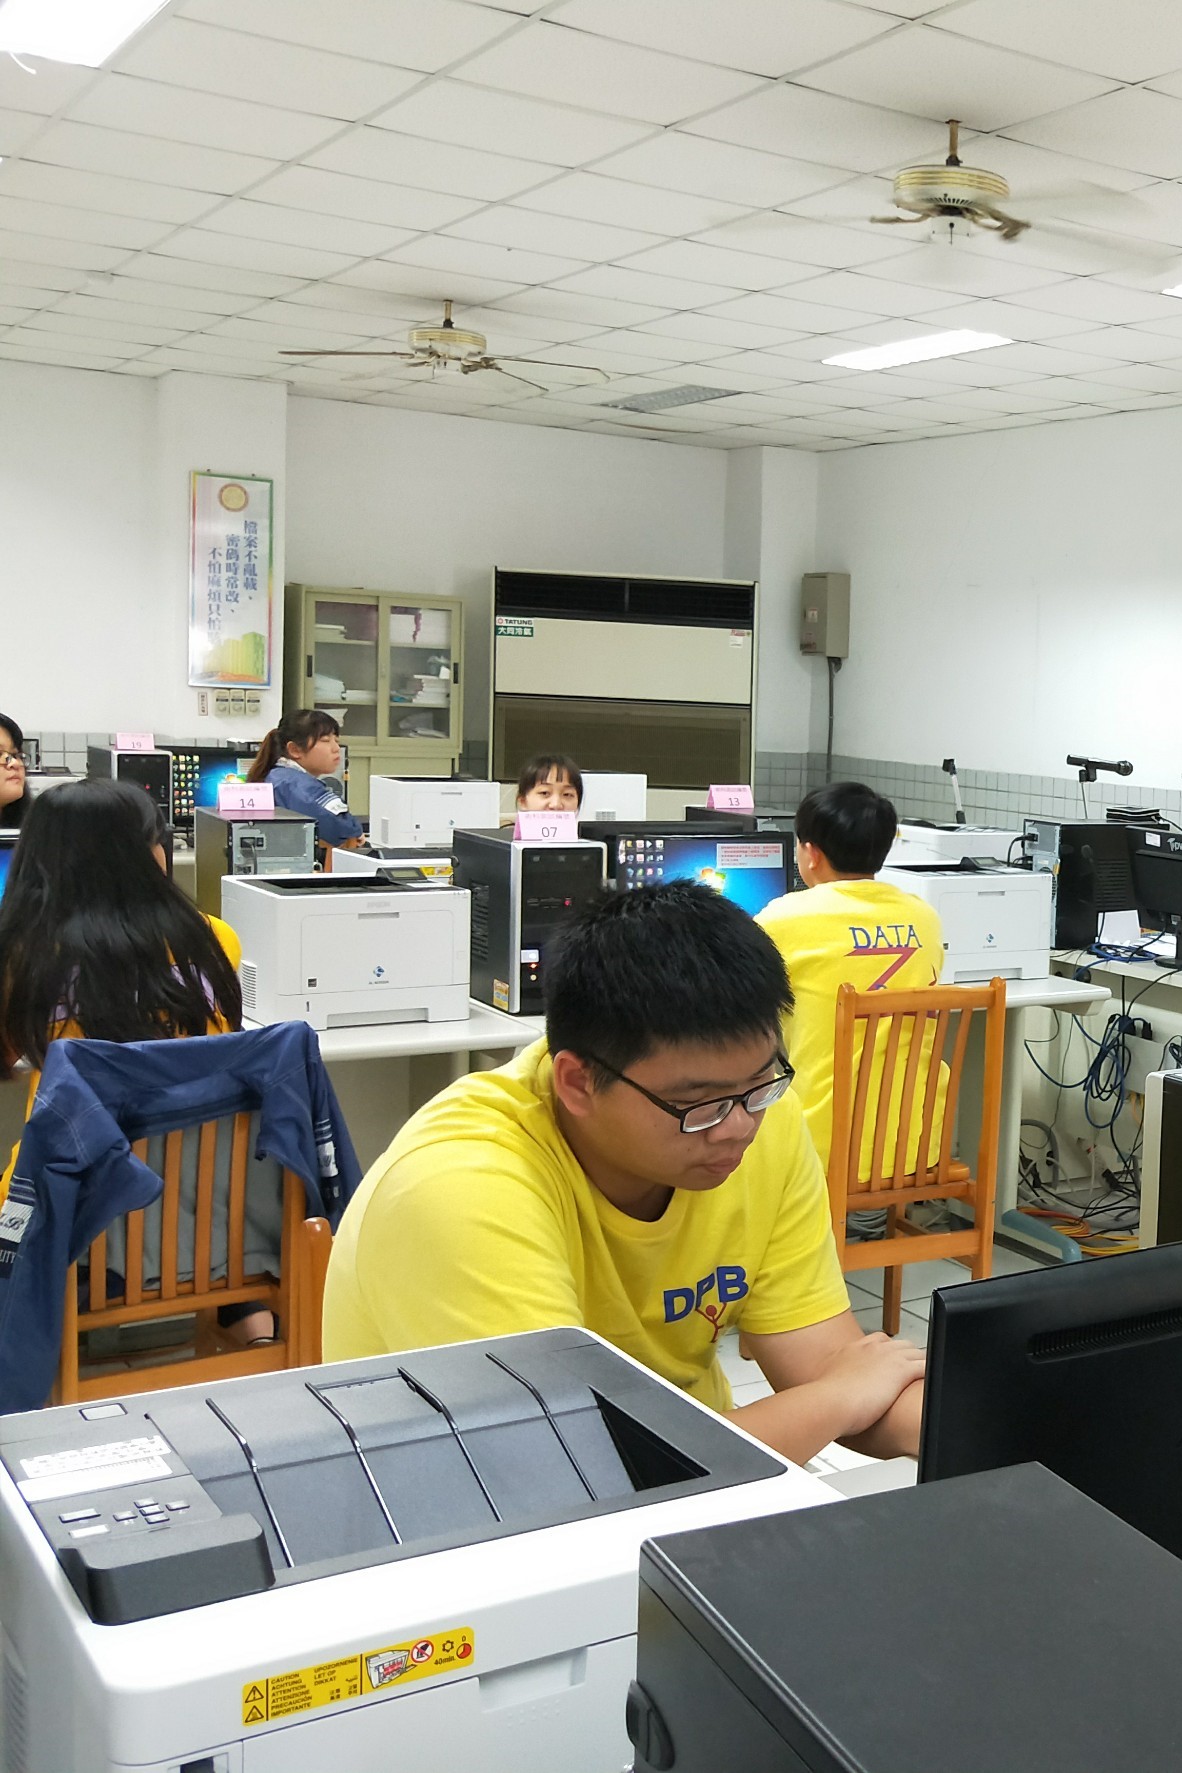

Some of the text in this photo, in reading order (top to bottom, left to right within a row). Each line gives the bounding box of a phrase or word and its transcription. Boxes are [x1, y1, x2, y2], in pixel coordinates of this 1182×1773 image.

[132, 741, 142, 749] 19
[240, 798, 255, 808] 14
[728, 797, 740, 807] 13
[541, 826, 557, 837] 07
[849, 924, 922, 949] DATA
[663, 1266, 749, 1323] DPB
[271, 1673, 299, 1684] CAUTION
[272, 1679, 302, 1690] ACHTUNG
[272, 1685, 306, 1697] ATTENTION
[272, 1690, 310, 1703] ATTENZIONE
[271, 1702, 311, 1716] IMPORTANTE
